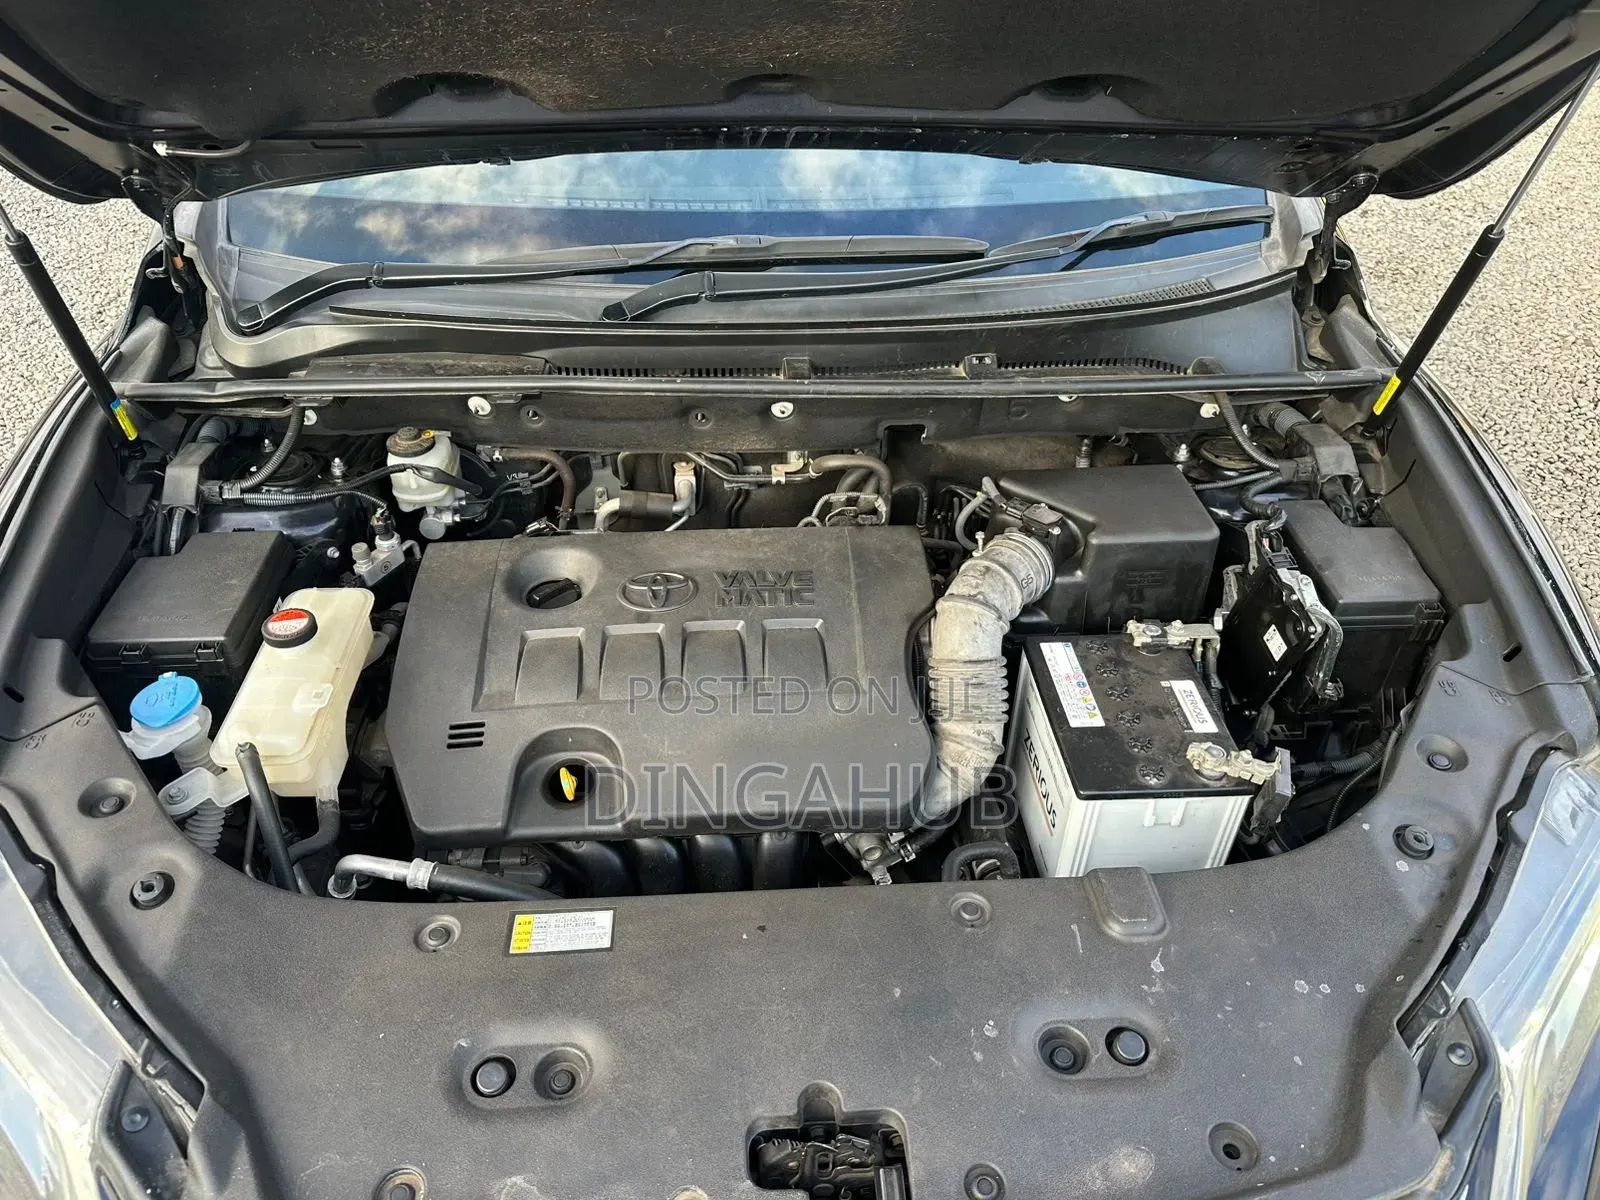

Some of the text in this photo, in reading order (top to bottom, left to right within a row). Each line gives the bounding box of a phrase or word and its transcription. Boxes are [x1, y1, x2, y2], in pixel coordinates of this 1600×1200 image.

[713, 569, 814, 588] VALVE
[715, 588, 815, 608] MATIC
[1182, 688, 1208, 725] ZERIOUS
[1023, 727, 1058, 829] ZERIOUS
